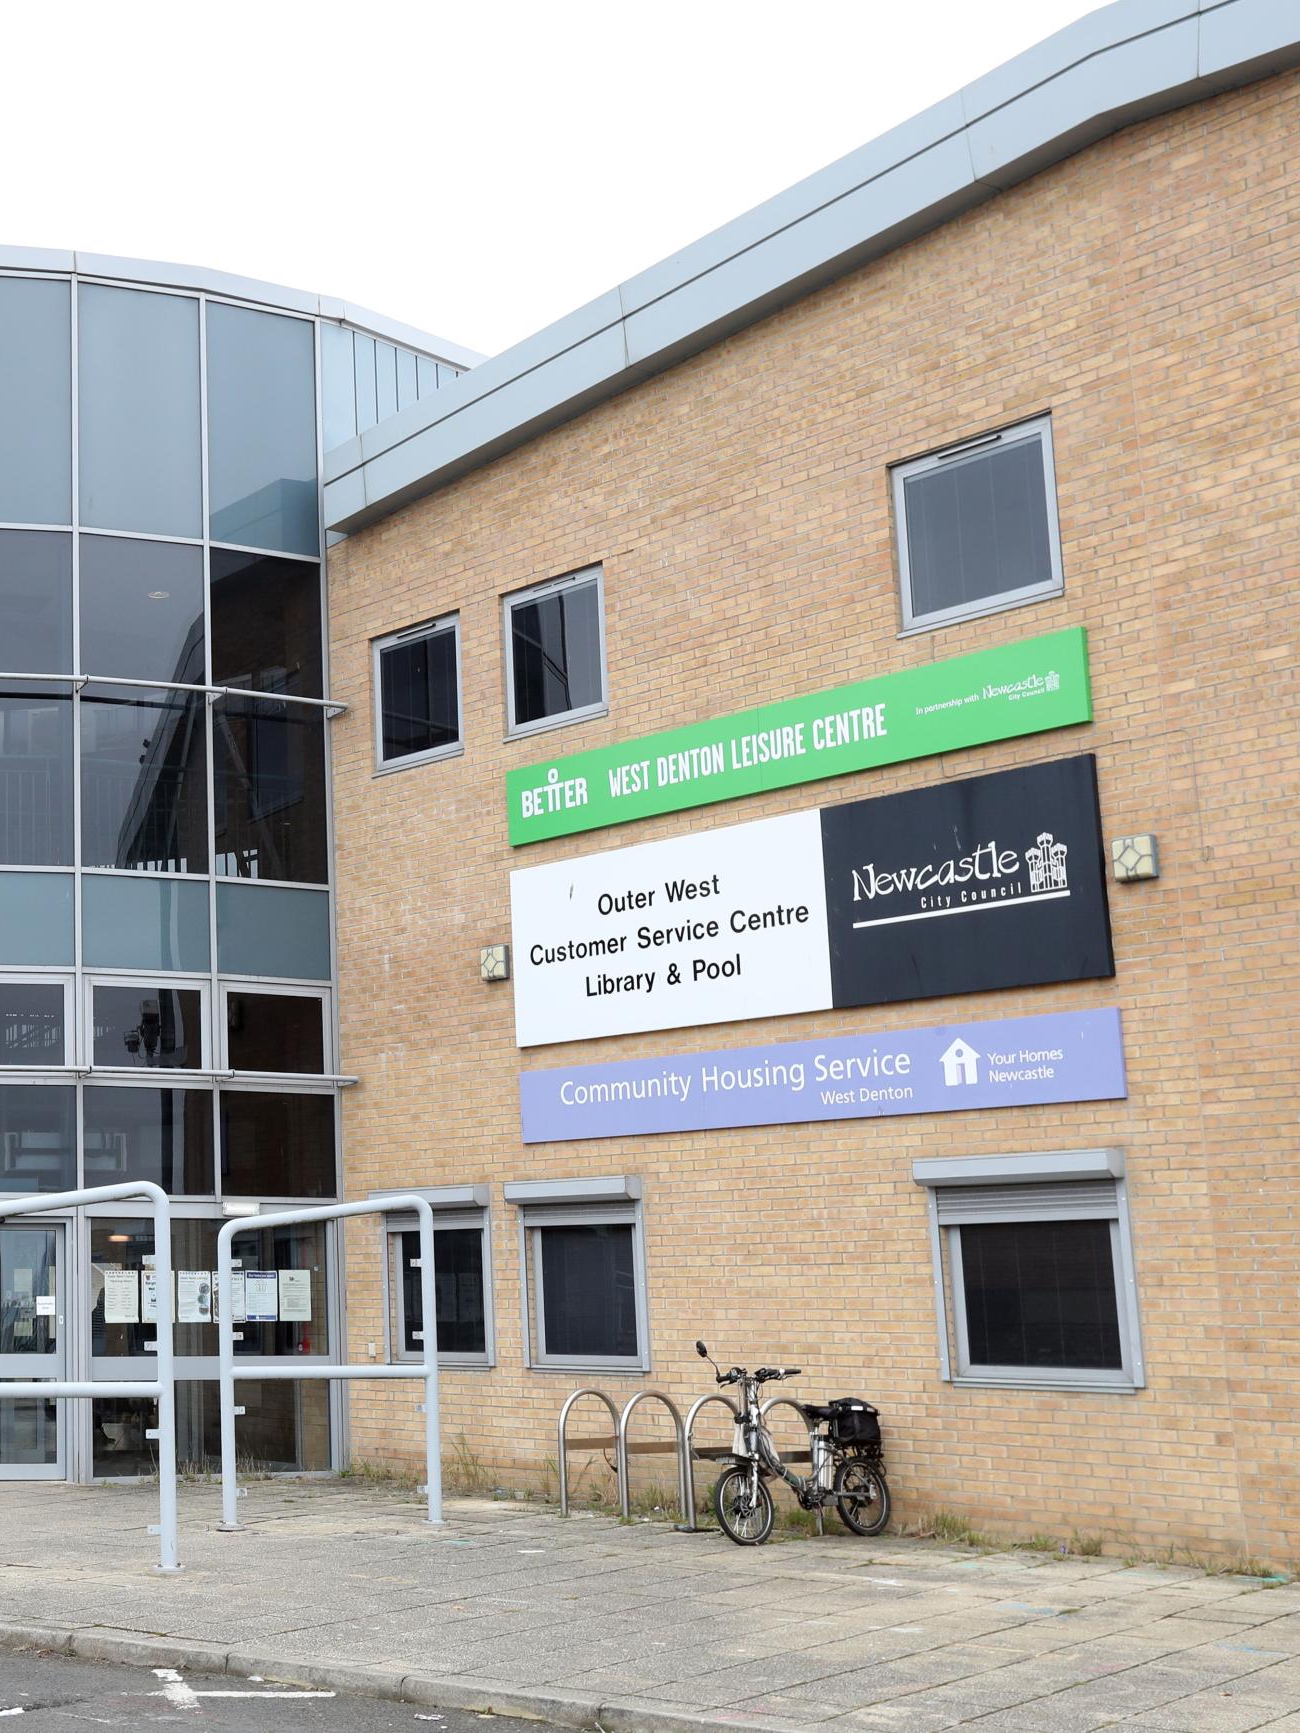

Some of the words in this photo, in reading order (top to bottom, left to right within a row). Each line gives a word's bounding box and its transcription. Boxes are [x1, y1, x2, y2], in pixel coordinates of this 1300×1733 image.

[915, 707, 923, 715] In
[924, 697, 962, 714] partnership
[963, 694, 979, 703] with
[982, 674, 1045, 700] Newcastle
[1008, 693, 1021, 701] City
[1021, 686, 1045, 698] Council
[608, 760, 650, 797] WEST
[656, 742, 725, 787] DENTON
[731, 722, 806, 770] LEISURE
[812, 703, 887, 750] CENTRE
[521, 767, 588, 819] BETTER
[851, 840, 1021, 902] Newcastle
[597, 890, 656, 916] Outer
[664, 874, 720, 903] West
[920, 895, 951, 909] City
[960, 881, 1022, 903] Council
[530, 935, 627, 966] Customer
[637, 919, 719, 949] Service
[730, 904, 809, 934] Centre
[585, 971, 656, 997] Library
[666, 962, 682, 986] &
[692, 953, 741, 982] Pool
[560, 1070, 692, 1109] Community
[701, 1059, 805, 1092] Housing
[814, 1048, 911, 1082] Service
[987, 1051, 1016, 1067] Your
[1019, 1048, 1064, 1063] Homes
[989, 1065, 1054, 1083] Newcastle
[820, 1090, 856, 1105] West
[859, 1086, 913, 1102] Denton
